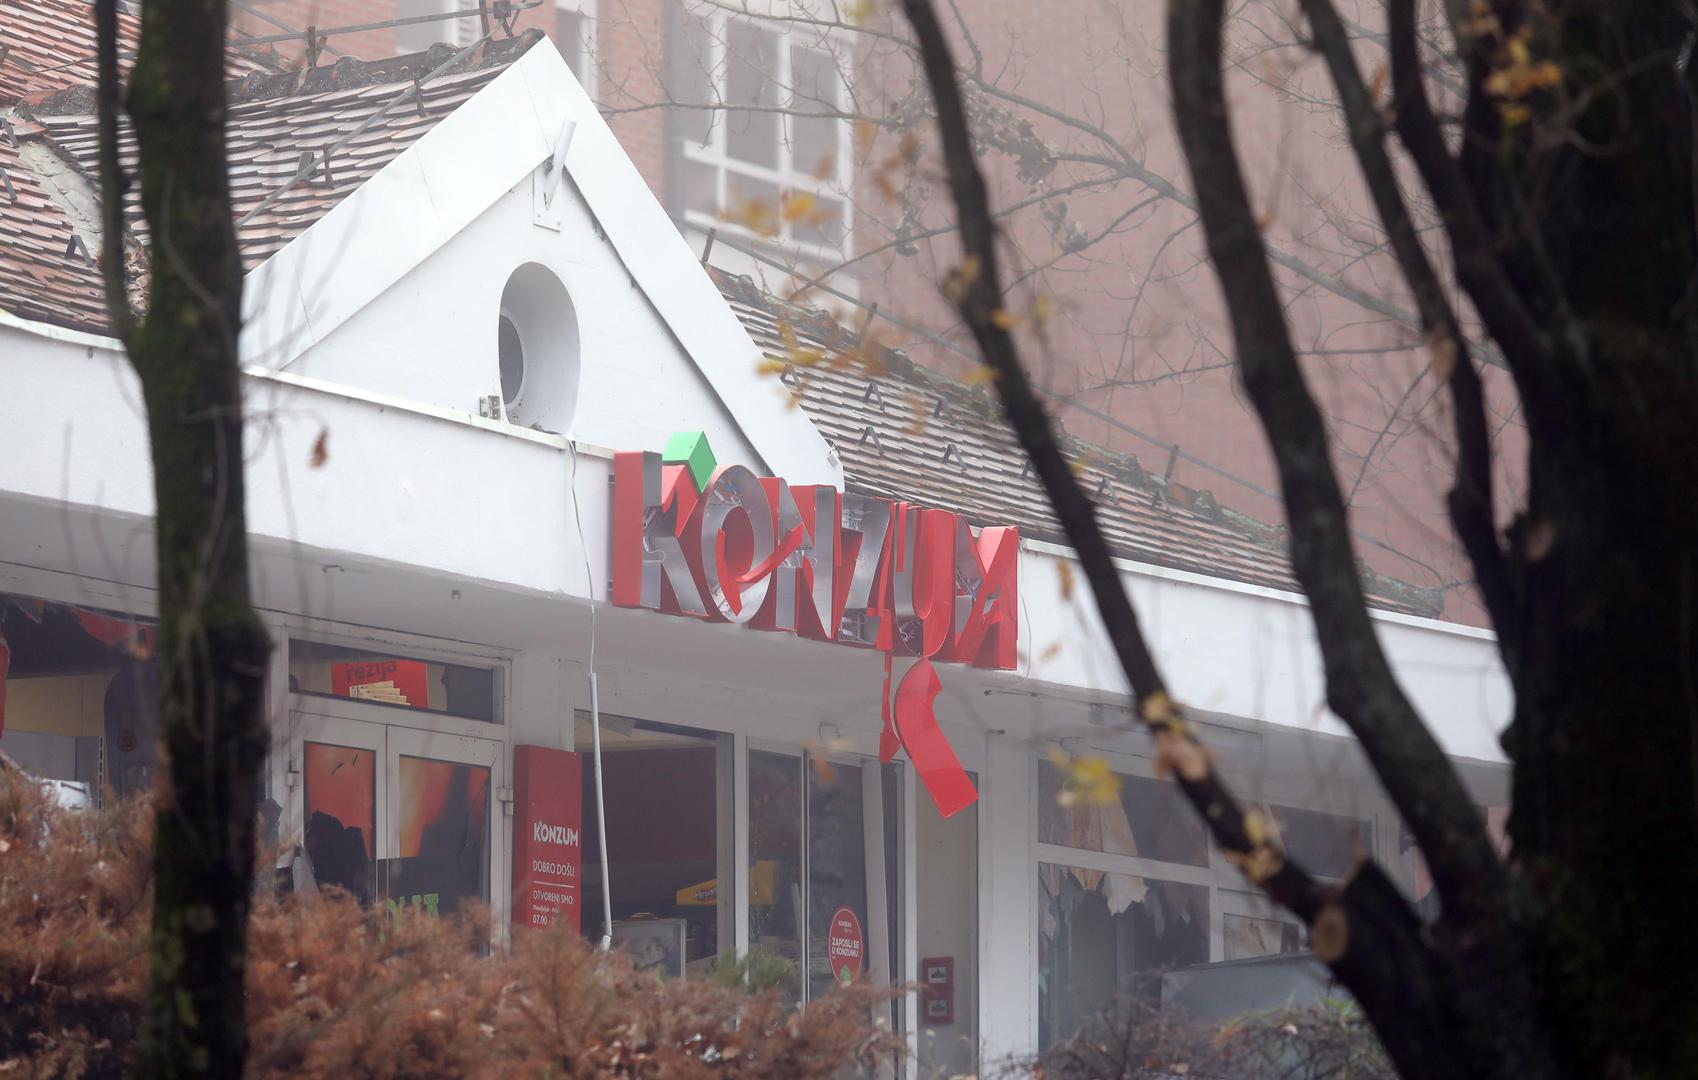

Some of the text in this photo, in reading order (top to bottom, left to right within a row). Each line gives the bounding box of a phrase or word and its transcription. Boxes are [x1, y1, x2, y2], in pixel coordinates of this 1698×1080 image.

[612, 432, 1019, 671] KONZUM
[533, 820, 579, 847] KONZUM
[533, 860, 575, 877] DOBRO DOŠLI
[533, 890, 560, 903] OTVORENI
[832, 937, 853, 948] ZAPOSLI
